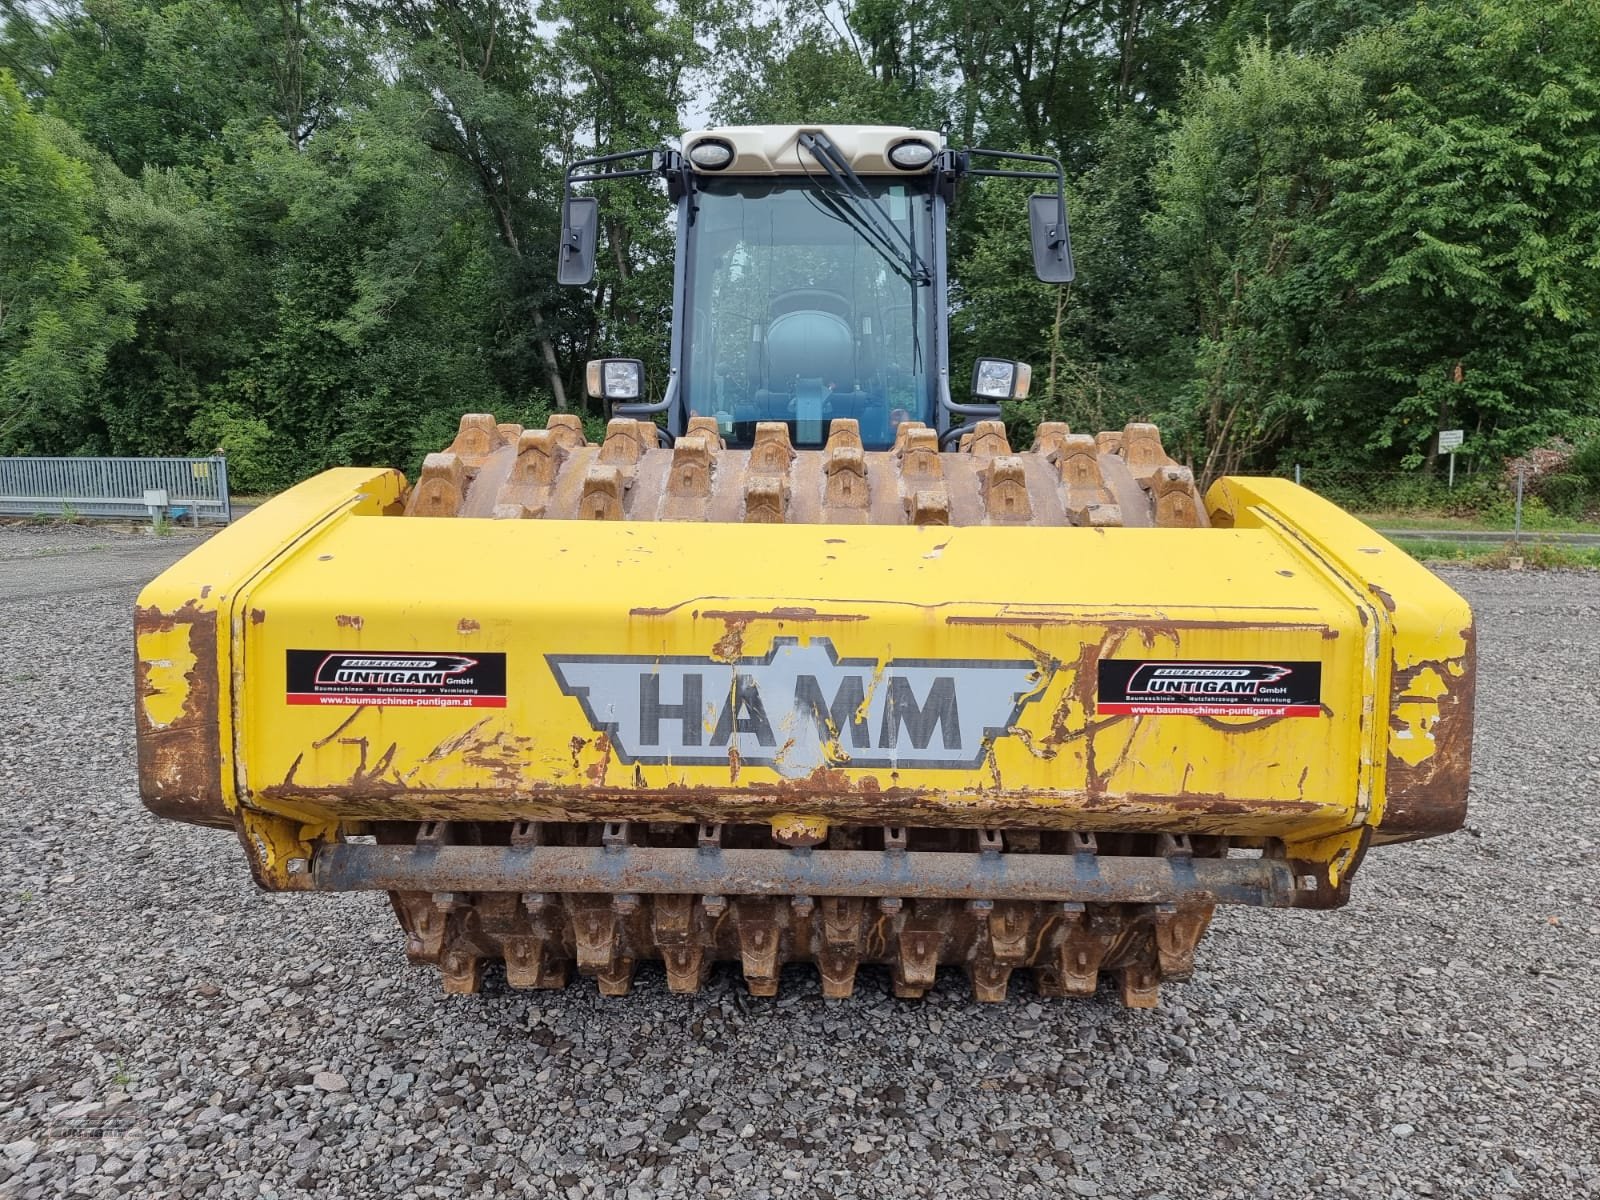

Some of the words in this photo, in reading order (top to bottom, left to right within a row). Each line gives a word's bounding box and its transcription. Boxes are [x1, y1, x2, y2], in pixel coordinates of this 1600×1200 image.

[446, 677, 474, 685] GmbH
[320, 697, 472, 707] www.baumaschinen-puntigam.at
[640, 673, 963, 750] HAMM
[1131, 706, 1285, 716] www.baumaschinen-puntigam.at
